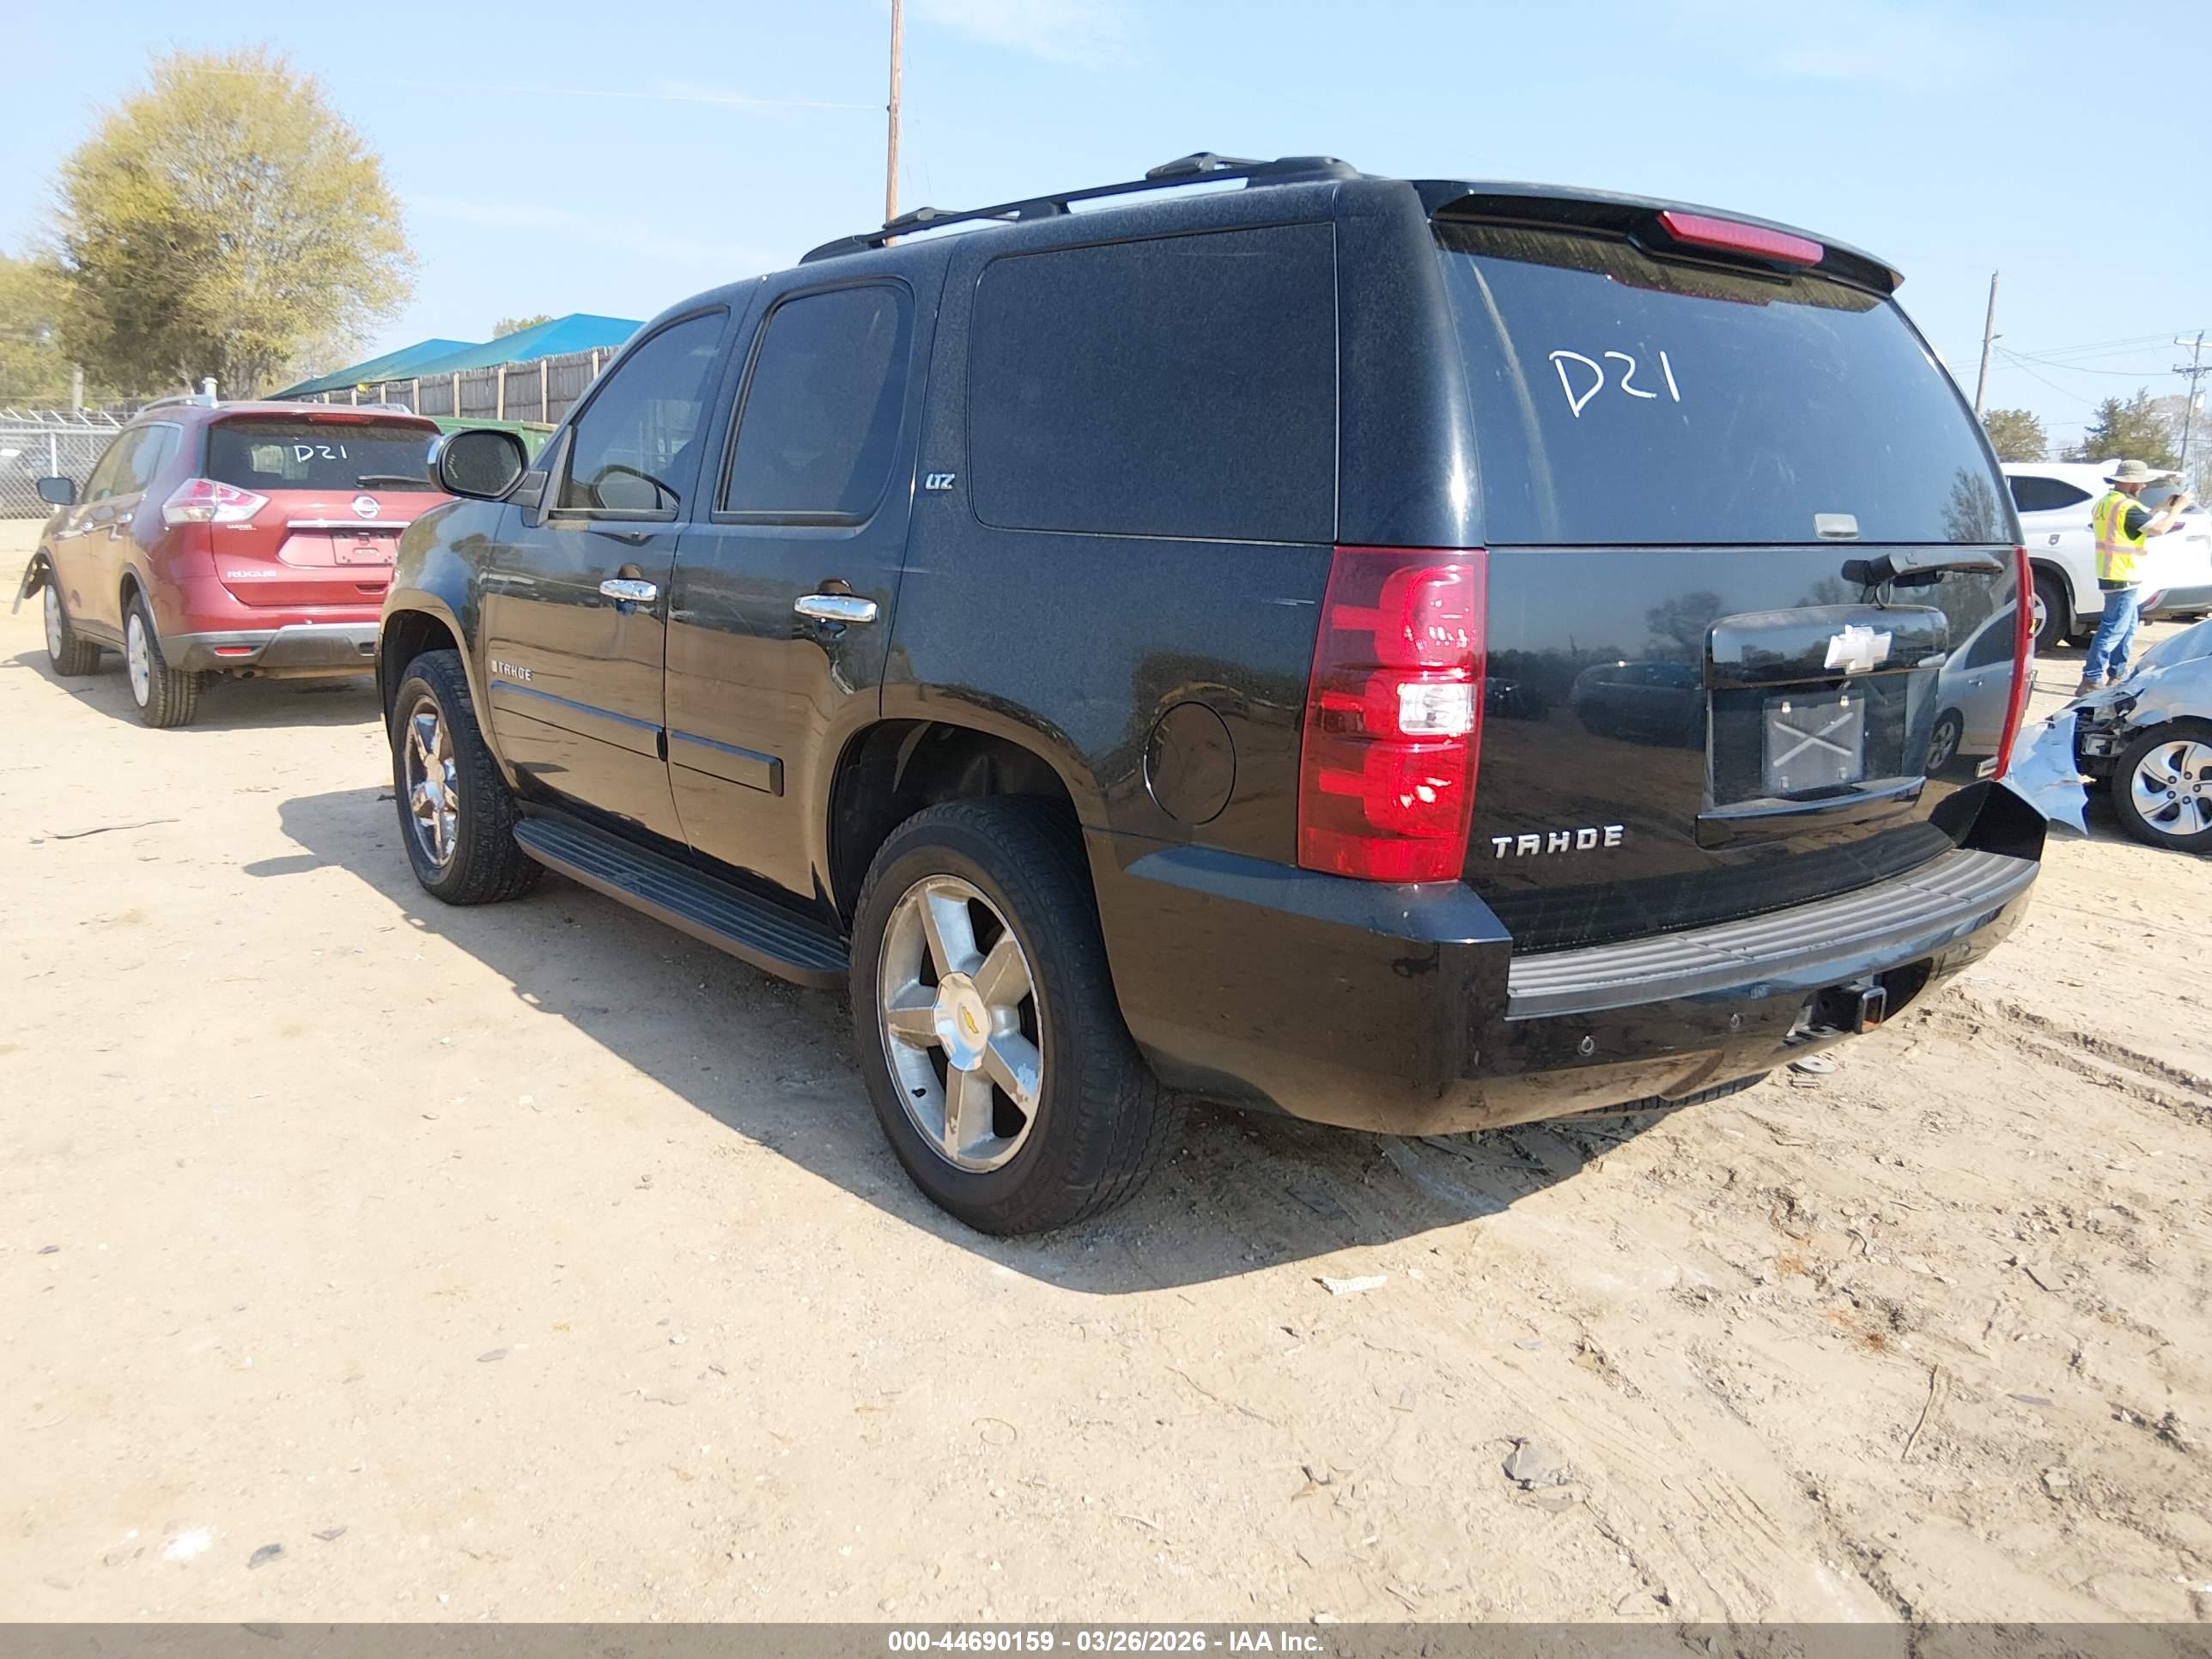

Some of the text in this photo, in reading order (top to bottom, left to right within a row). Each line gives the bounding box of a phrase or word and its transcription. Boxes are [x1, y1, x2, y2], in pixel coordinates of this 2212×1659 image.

[1549, 350, 1680, 418] D21
[294, 445, 347, 463] D21
[926, 473, 955, 489] LTZ
[498, 660, 532, 681] TAHOE
[1492, 824, 1624, 859] TAHOE
